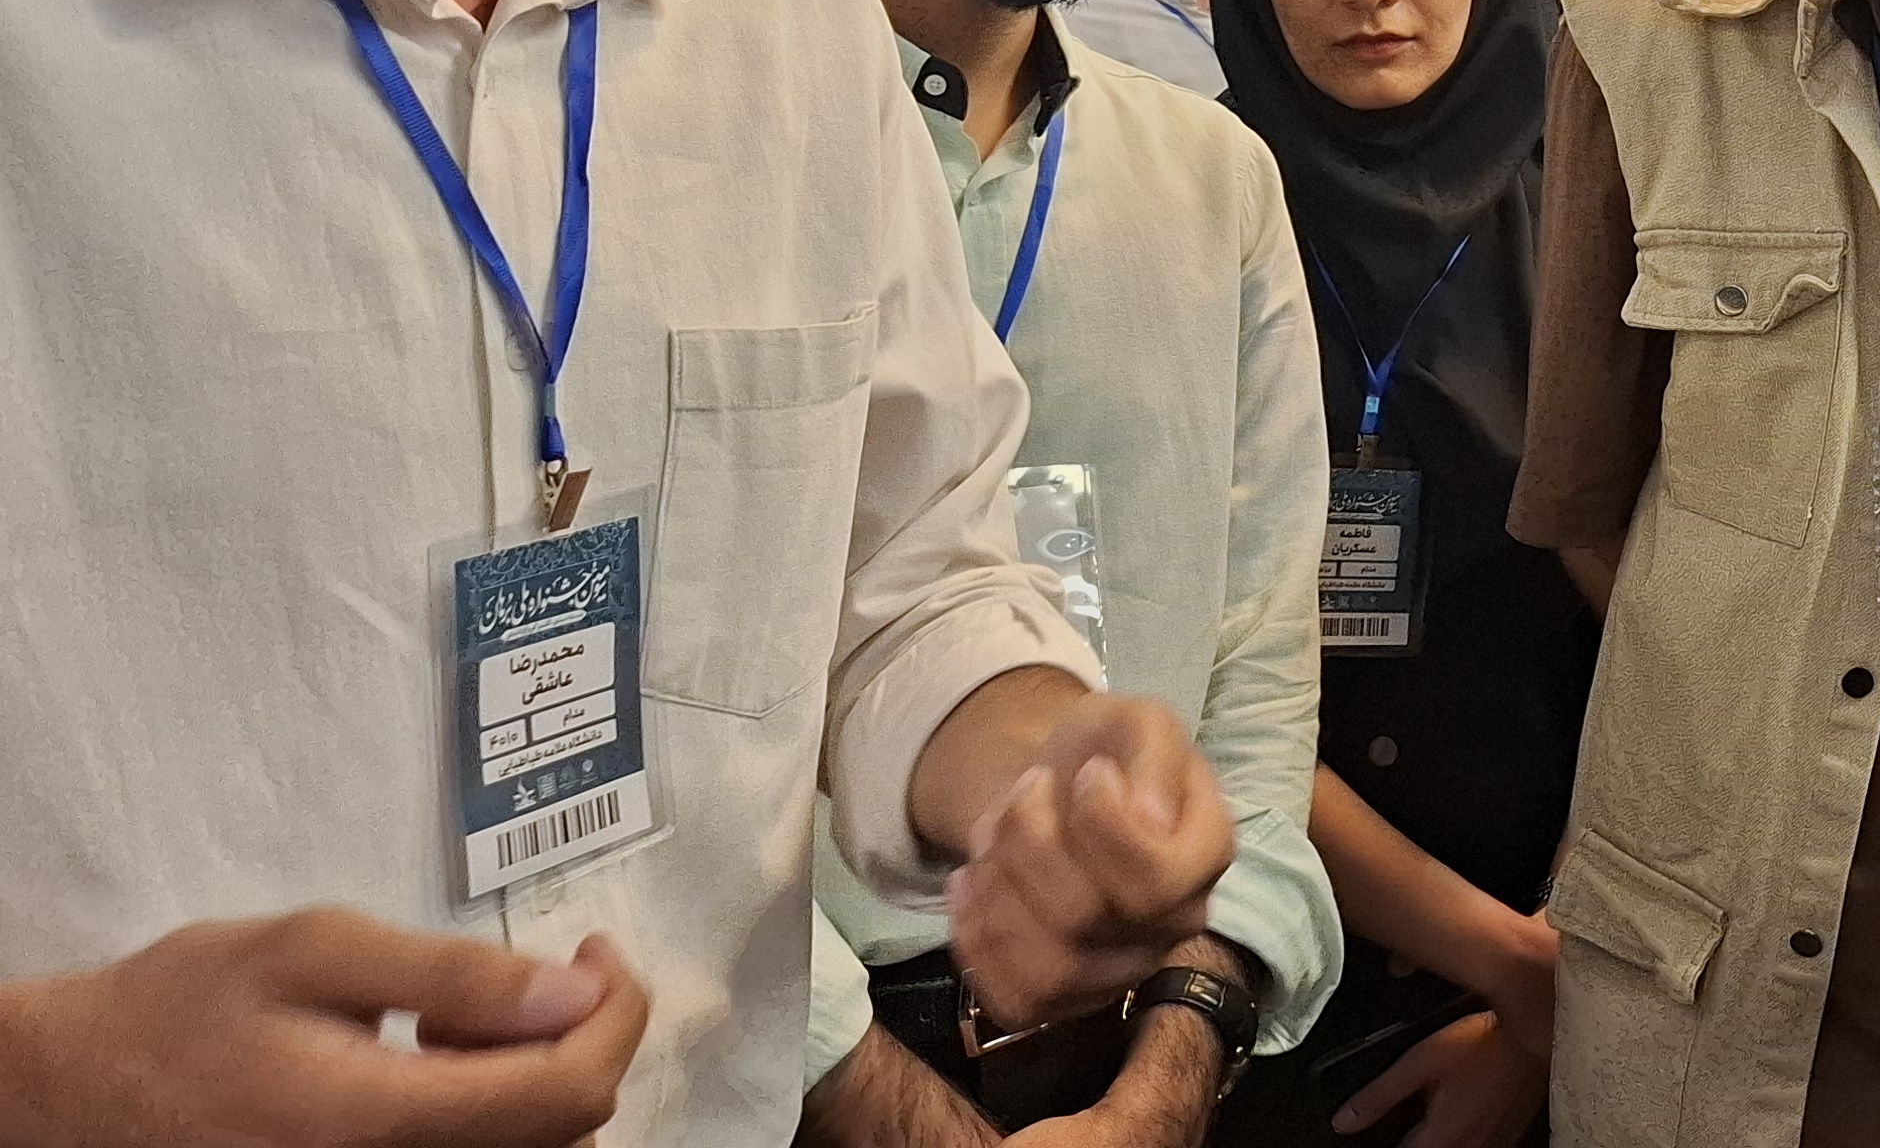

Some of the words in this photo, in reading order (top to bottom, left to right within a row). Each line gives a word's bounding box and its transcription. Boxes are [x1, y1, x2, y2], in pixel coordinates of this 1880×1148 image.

[1340, 526, 1372, 539] فاطمه
[509, 643, 585, 675] محمدرضا
[522, 670, 574, 705] عاشقی
[568, 730, 603, 749] دانشگاه
